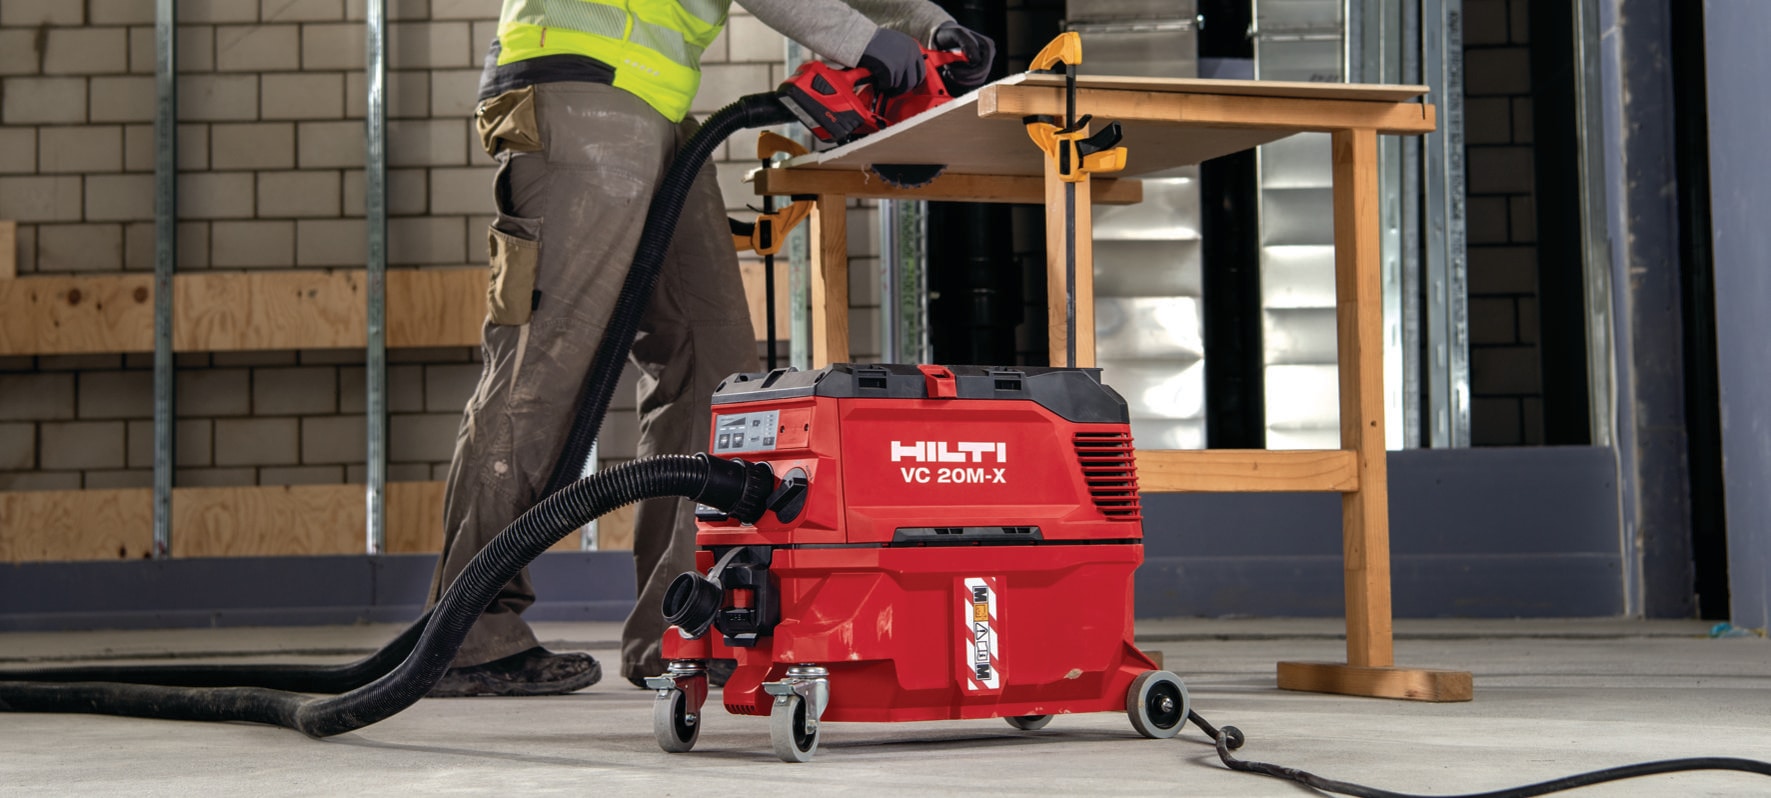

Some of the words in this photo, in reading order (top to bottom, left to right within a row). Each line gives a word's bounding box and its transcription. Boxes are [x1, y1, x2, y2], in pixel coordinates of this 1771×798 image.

[891, 441, 1006, 463] HILTI
[901, 467, 931, 483] VC
[937, 467, 1006, 484] 20M-X
[974, 588, 987, 602] M
[977, 664, 990, 679] M
